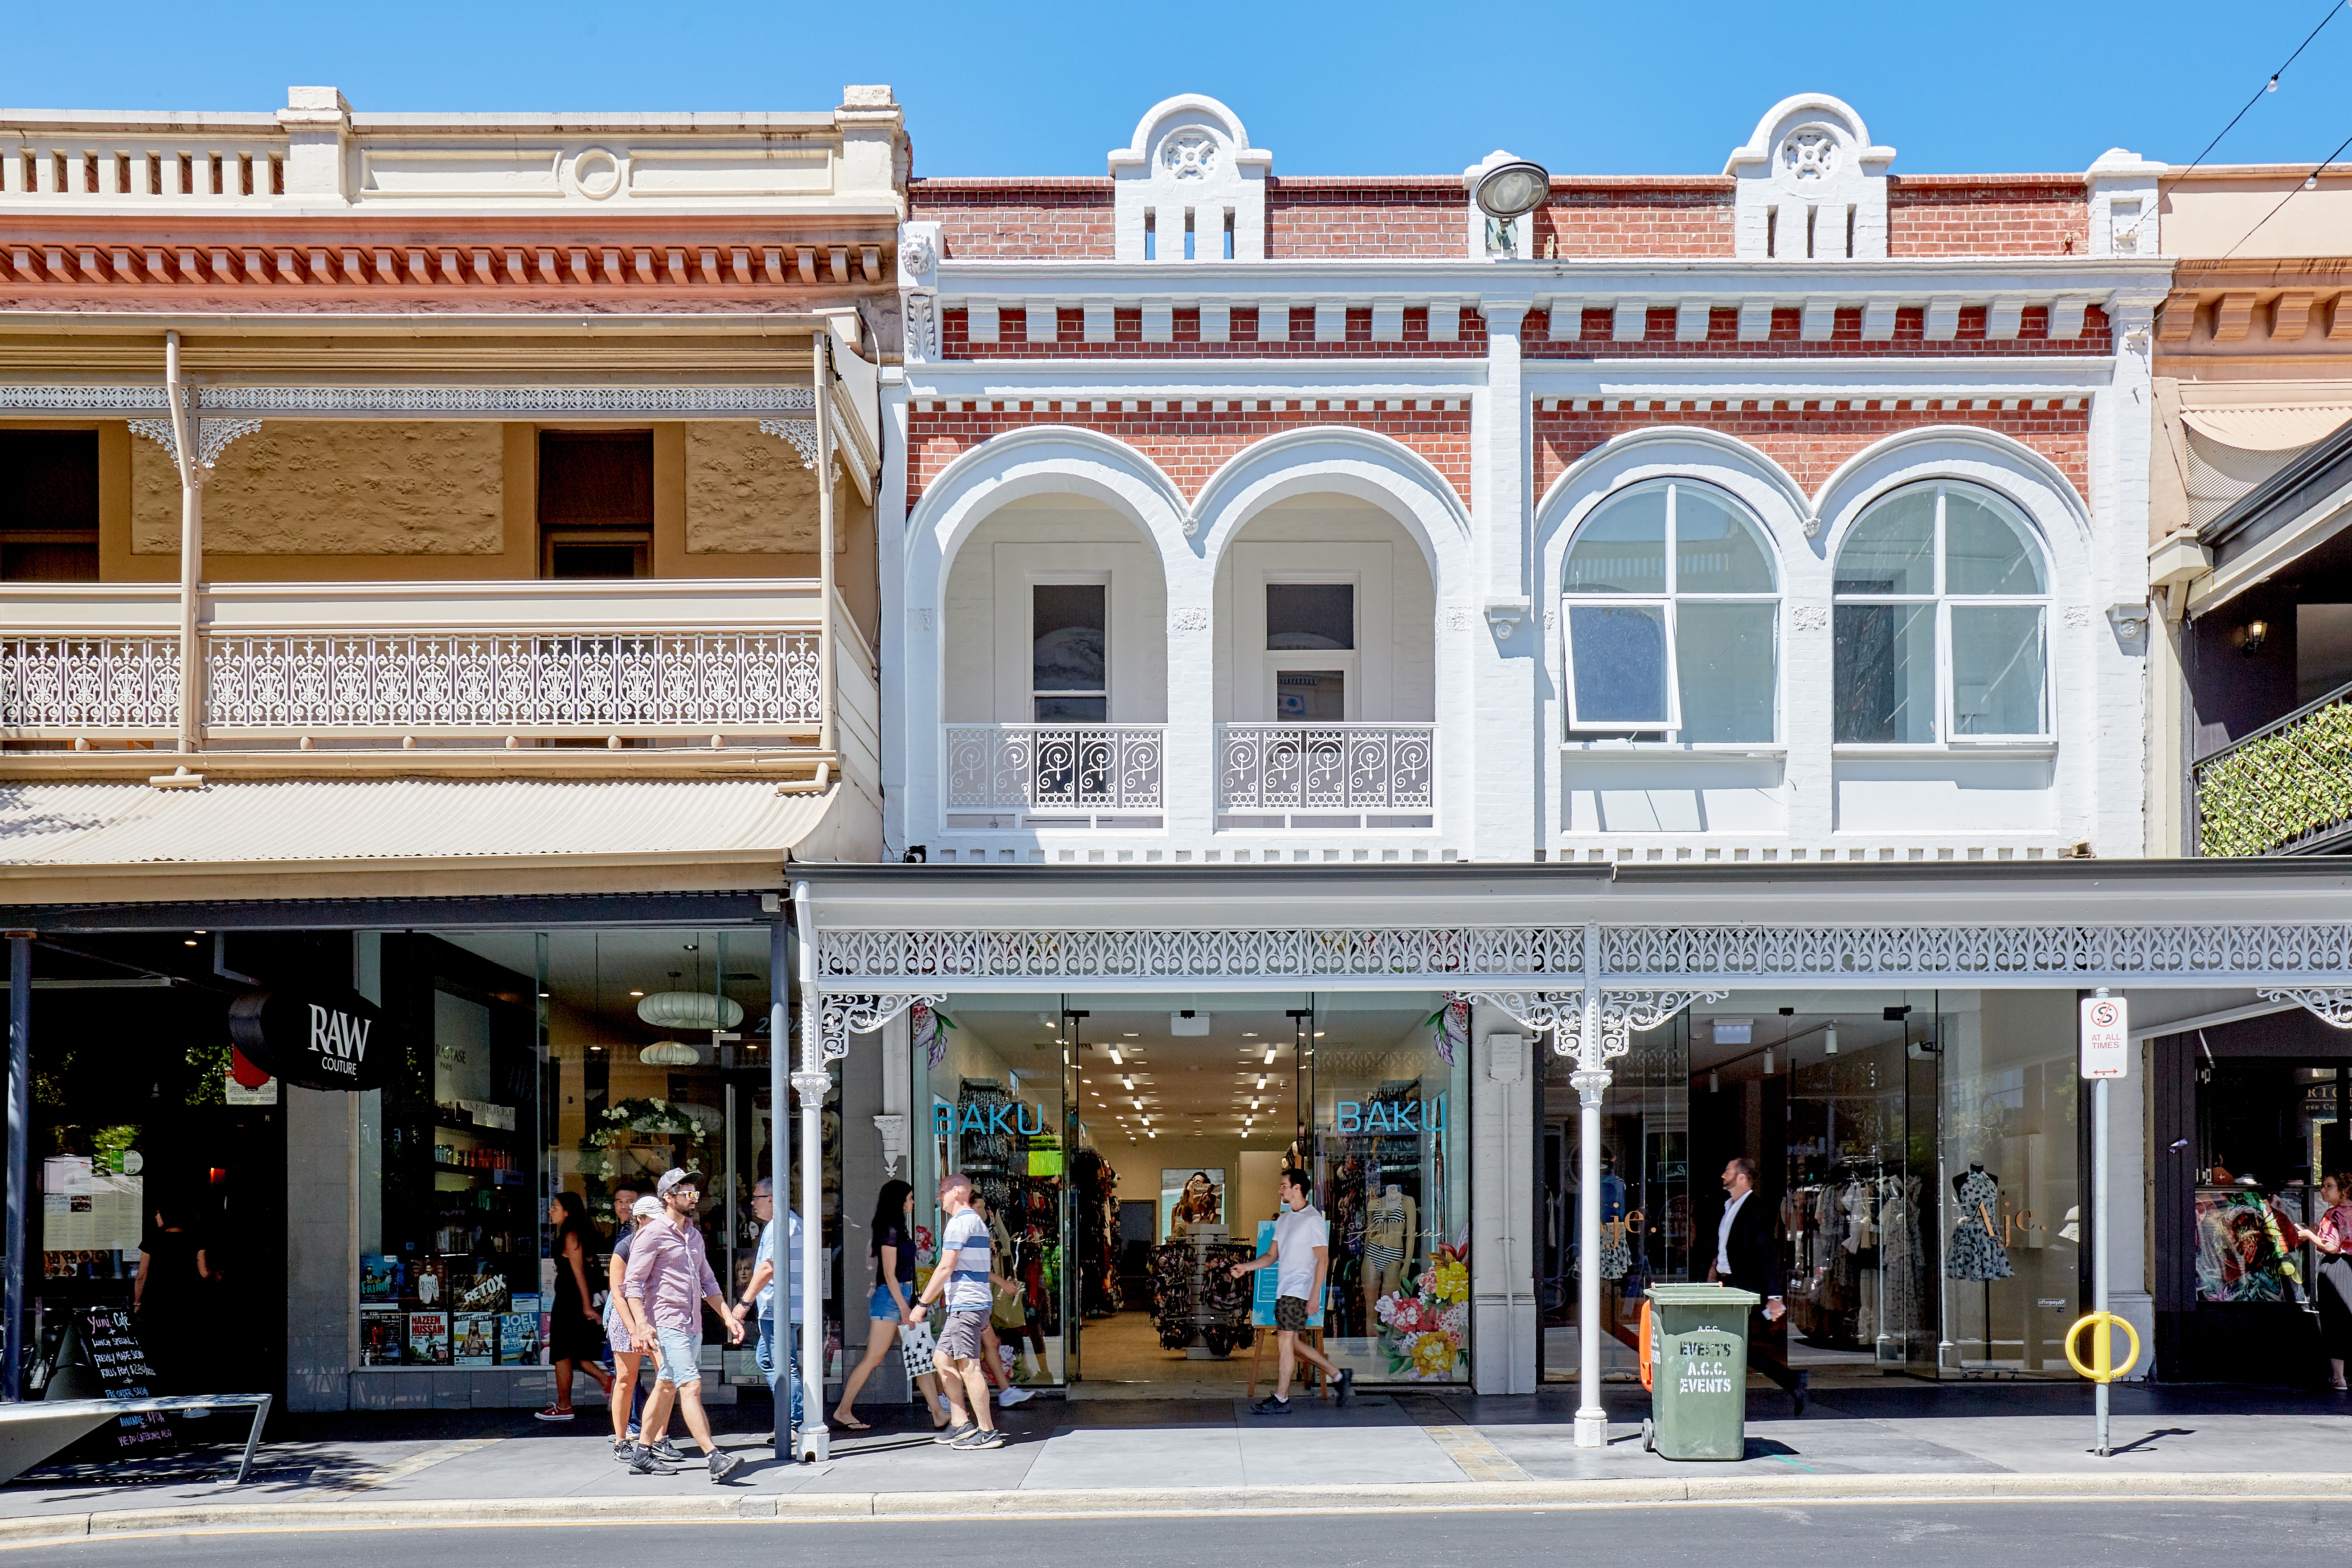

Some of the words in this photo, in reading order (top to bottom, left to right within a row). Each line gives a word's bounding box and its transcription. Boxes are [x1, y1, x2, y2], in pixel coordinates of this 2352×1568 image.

[308, 1003, 372, 1061] RAW
[322, 1056, 356, 1075] COUTURE
[933, 1104, 1042, 1134] BAKU
[1338, 1101, 1446, 1132] BAKU
[1600, 1202, 1657, 1249] je.
[464, 1274, 507, 1304] RETOX
[87, 1314, 112, 1334] Yumi
[412, 1316, 441, 1325] NAZEEM
[502, 1313, 537, 1327] JOEL
[412, 1324, 445, 1335] HUSSAIN
[502, 1323, 537, 1335] CREASEY
[92, 1338, 111, 1347] LUNCH
[1680, 1342, 1731, 1357] EVENTS
[116, 1351, 132, 1361] MADE
[1687, 1362, 1726, 1376] A.C.C.
[1679, 1378, 1731, 1394] EVENTS
[118, 1436, 130, 1447] WE
